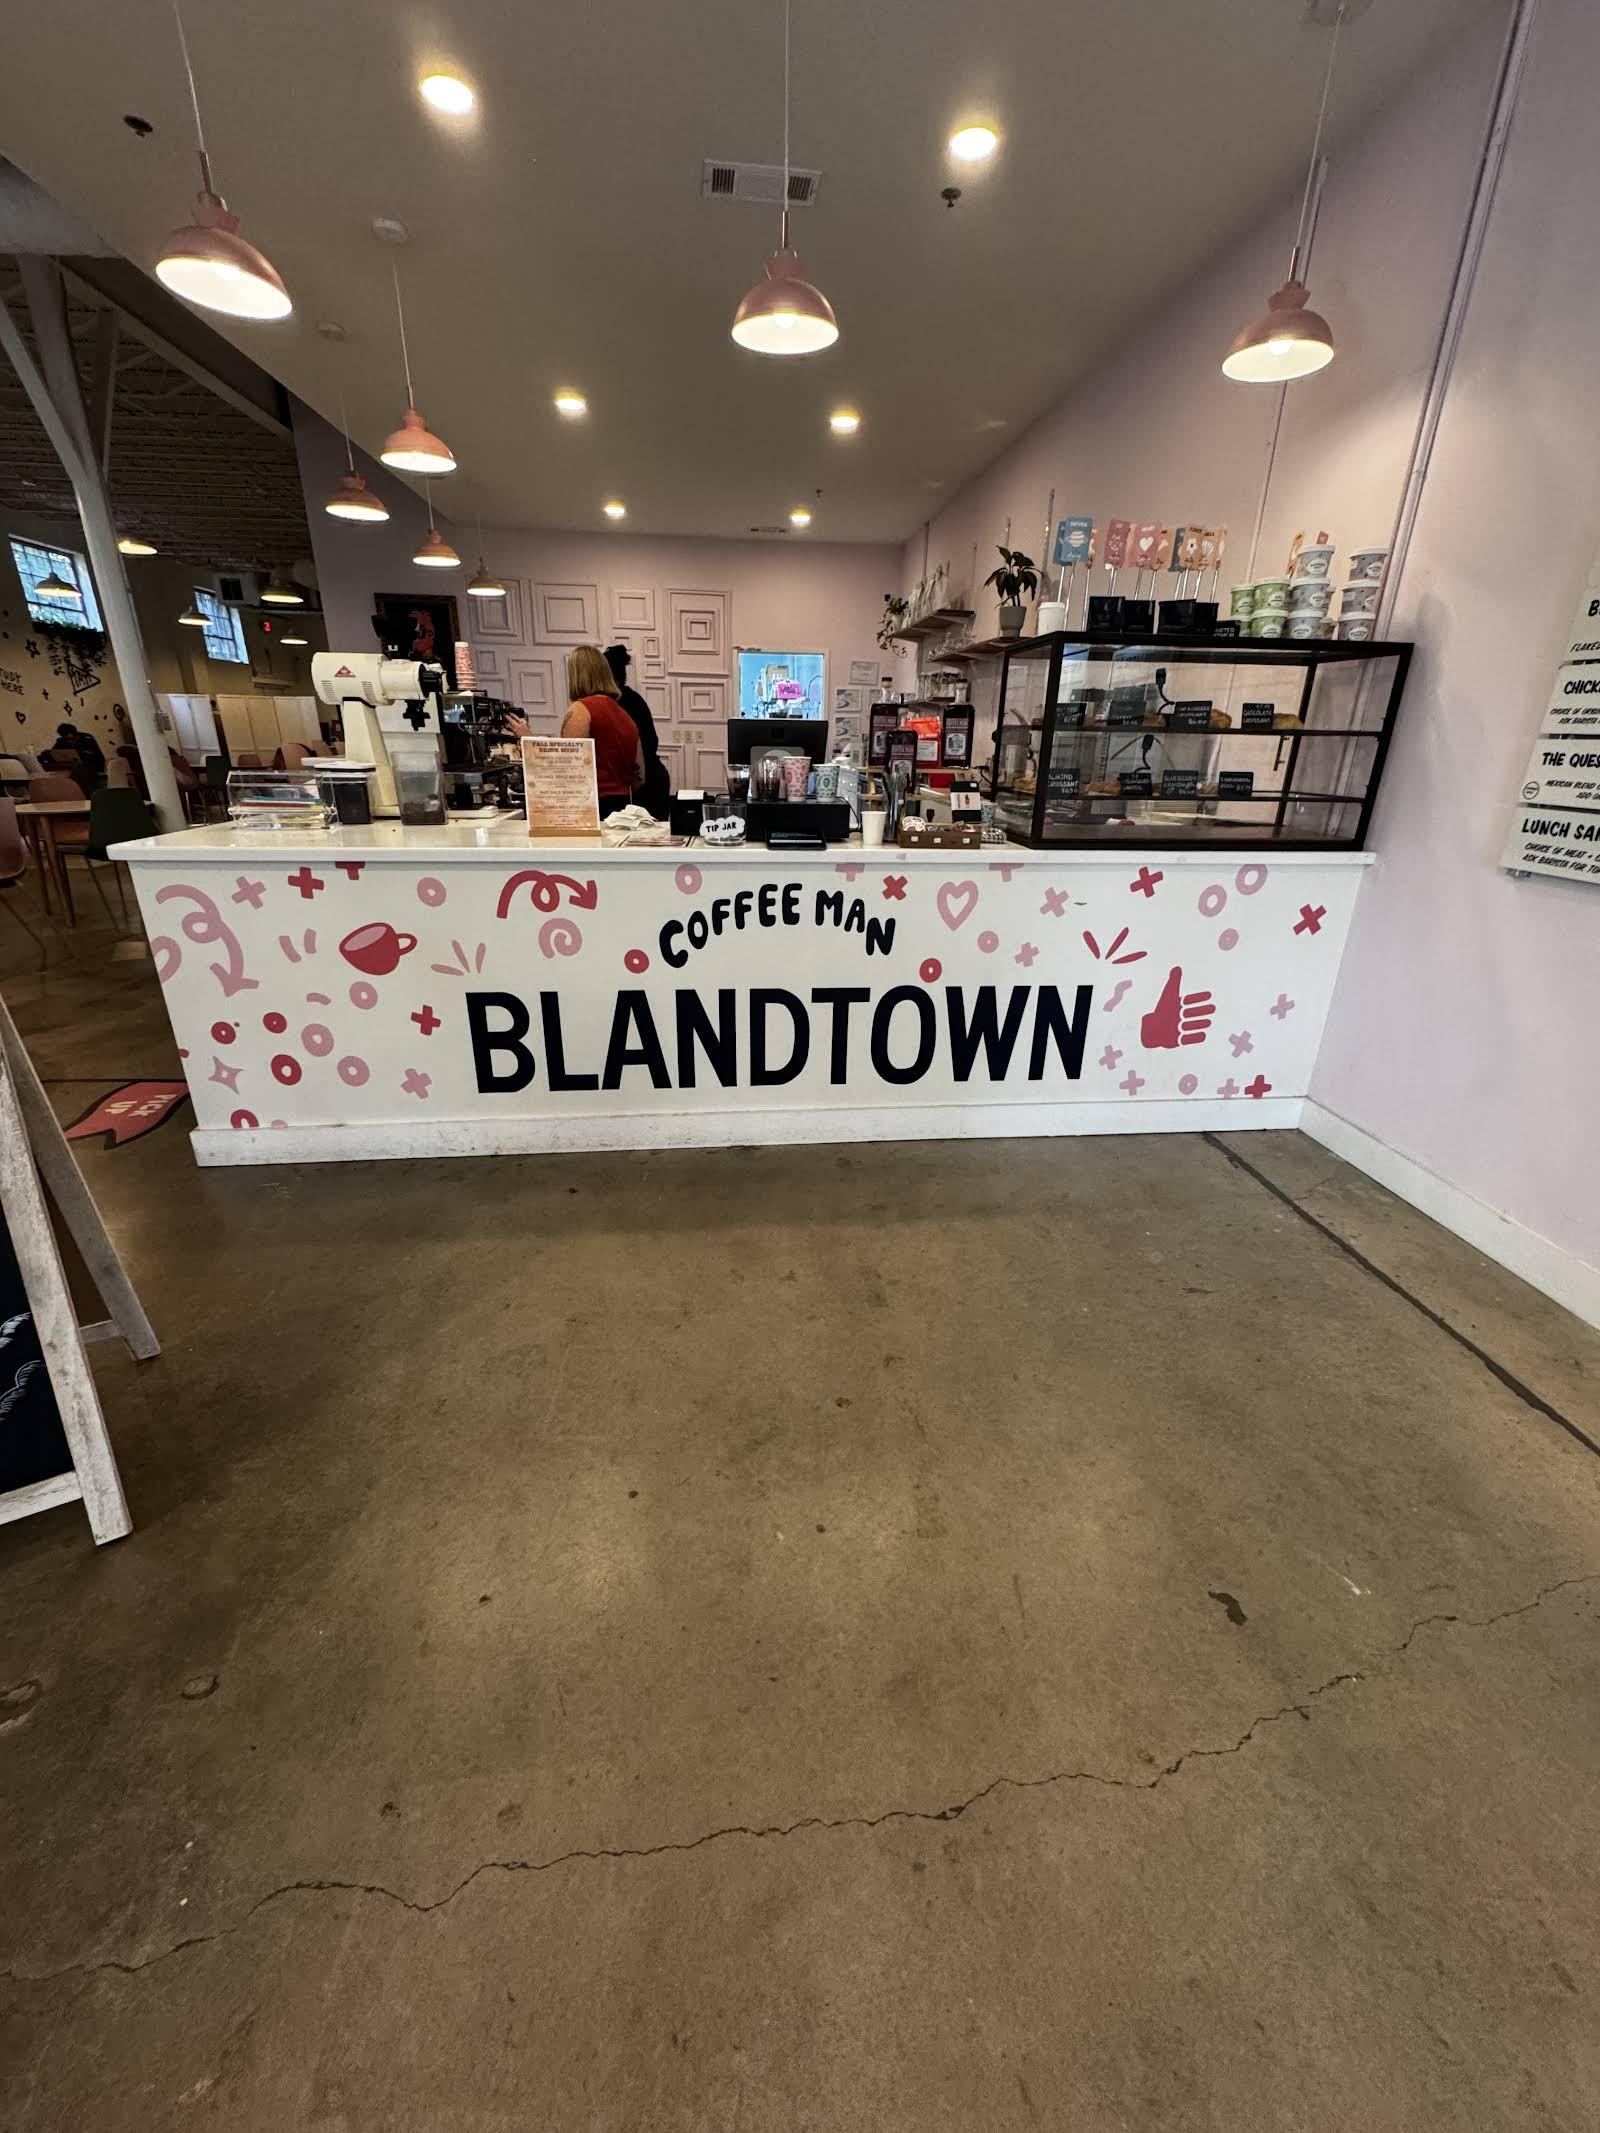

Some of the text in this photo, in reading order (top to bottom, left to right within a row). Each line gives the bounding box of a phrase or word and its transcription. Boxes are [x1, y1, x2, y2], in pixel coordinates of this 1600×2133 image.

[1564, 679, 1600, 695] CHICK
[1542, 752, 1566, 767] THE
[706, 822, 737, 832] TIP JAR
[1522, 818, 1571, 838] LUNCH
[1525, 843, 1552, 853] CHOICE
[1552, 846, 1565, 855] OF
[1563, 849, 1588, 858] MEAT
[1522, 854, 1540, 862] ASK
[1537, 856, 1569, 868] BARISTA
[1568, 861, 1588, 871] FOR
[659, 883, 895, 968] COFFEE MAN
[465, 985, 1094, 1094] BLANDTOWN
[105, 1100, 138, 1114] UP
[127, 1093, 177, 1117] PICK
